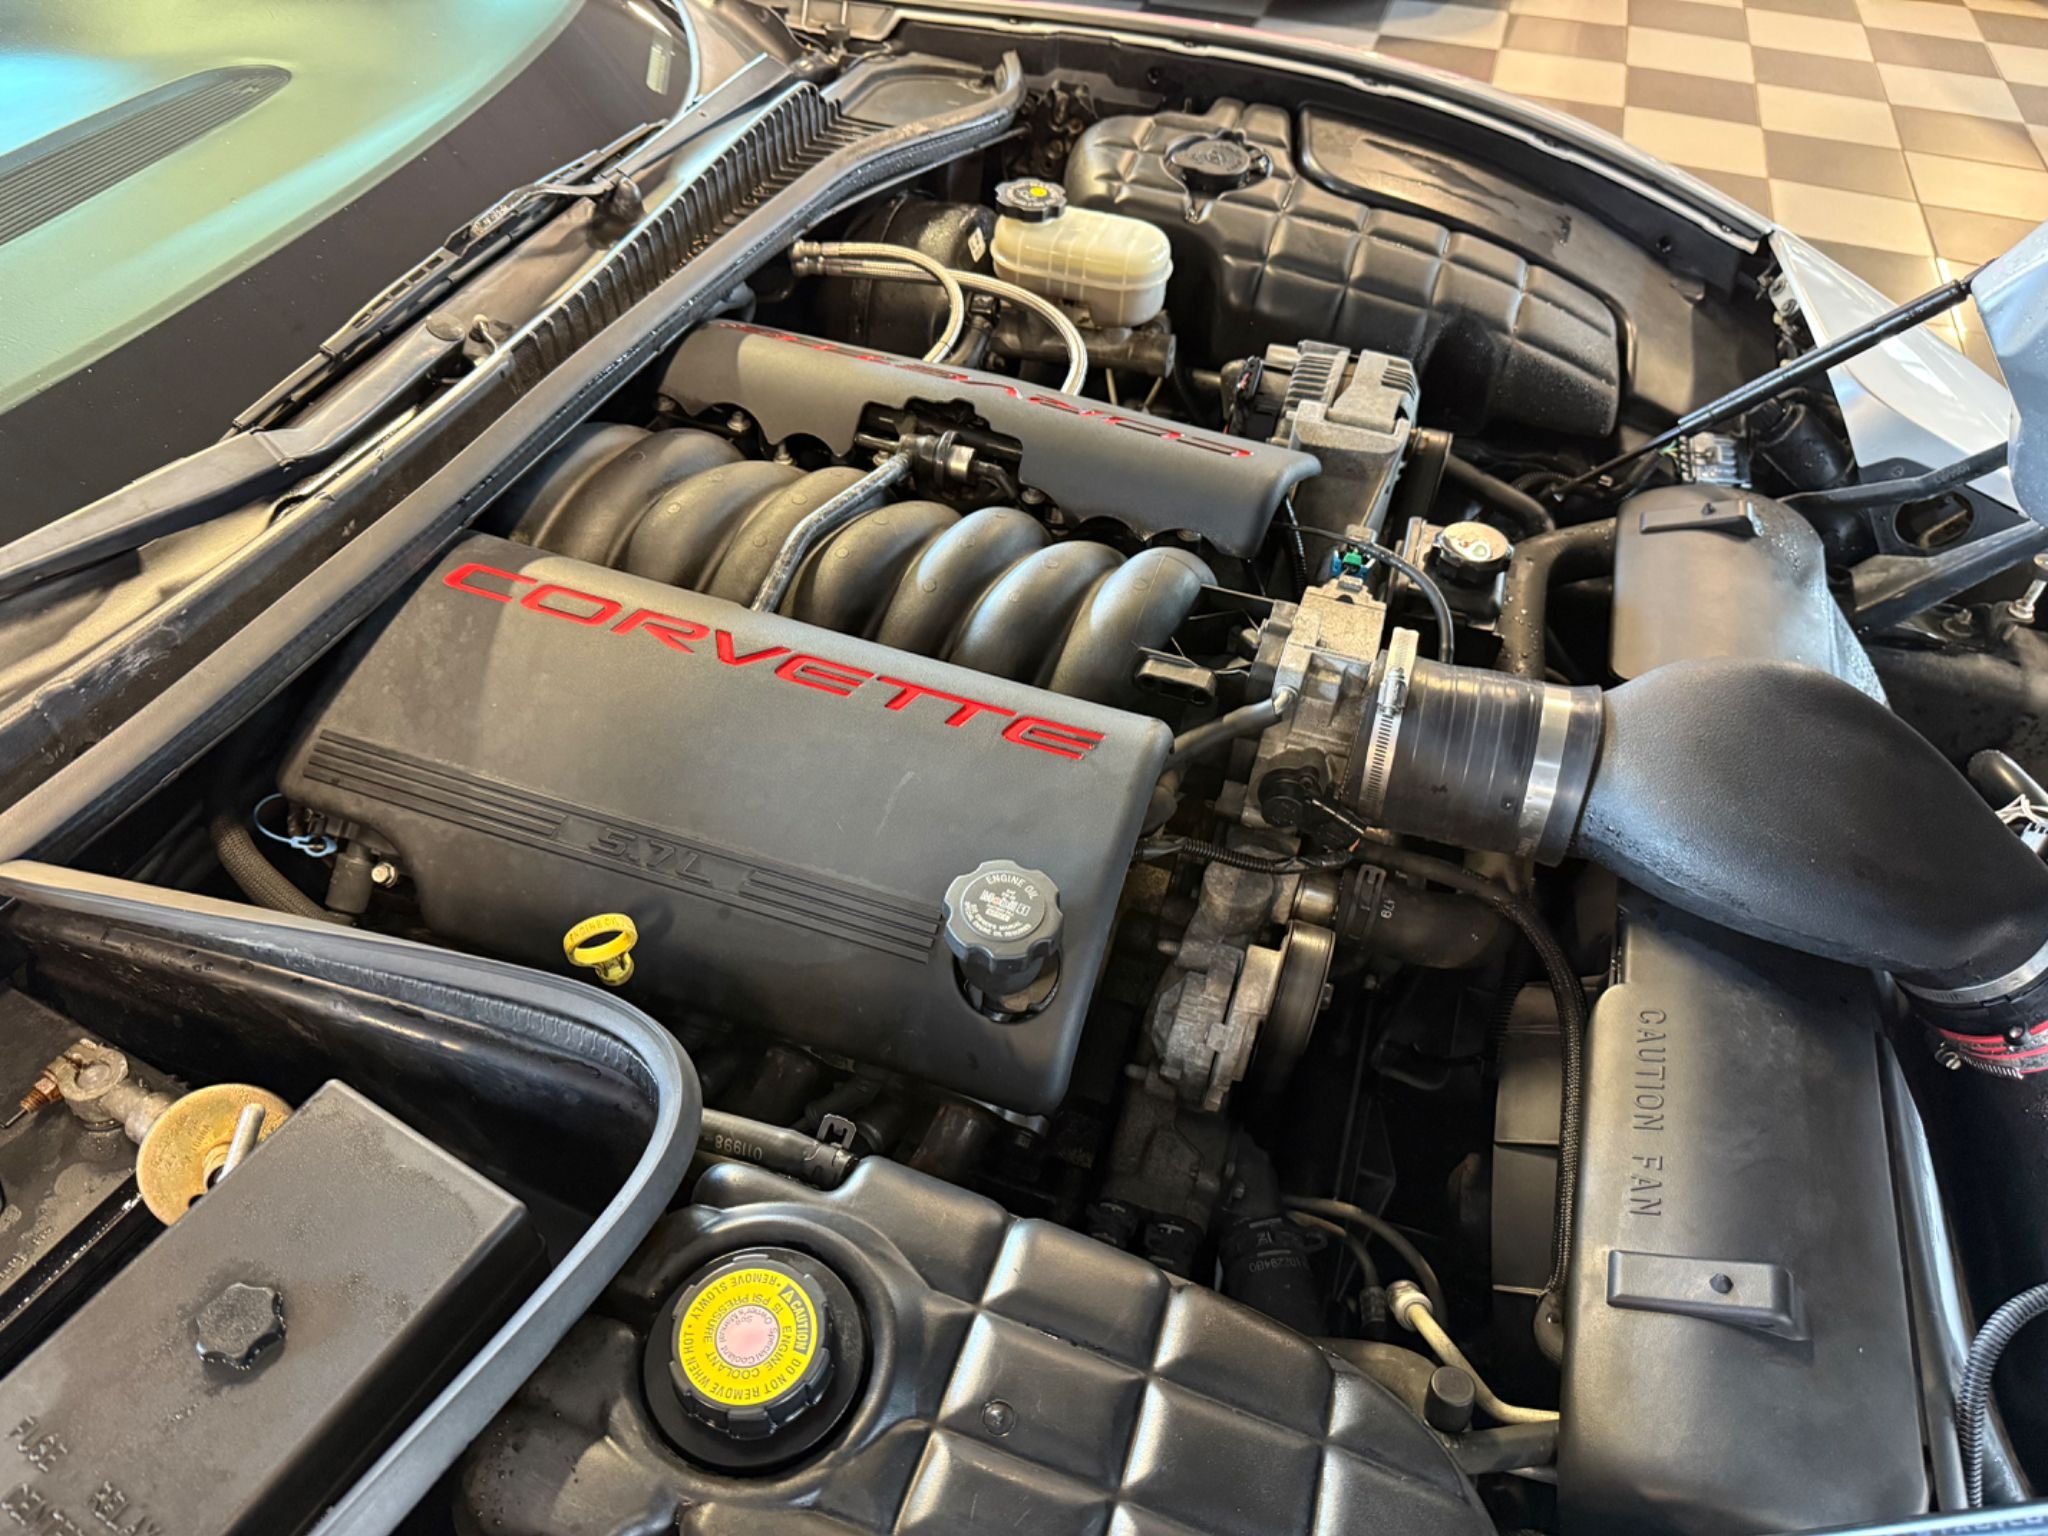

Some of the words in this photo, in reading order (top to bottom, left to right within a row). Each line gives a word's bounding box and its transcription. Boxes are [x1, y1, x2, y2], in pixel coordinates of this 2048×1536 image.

[441, 561, 1106, 762] CORVETTE
[589, 827, 712, 886] 5.7L
[985, 873, 1026, 888] ENGINE
[1024, 884, 1039, 900] OIL
[1632, 1008, 1667, 1131] CAUTION
[714, 1133, 763, 1161] 011998
[1628, 1155, 1664, 1217] FAN
[731, 1273, 778, 1288] REMOVE
[693, 1281, 728, 1320] SLOWLY
[751, 1293, 771, 1306] PSI
[772, 1302, 784, 1315] 15
[702, 1293, 749, 1344] PRESSURE
[718, 1313, 740, 1343] Manual
[739, 1308, 773, 1325] Owner's
[789, 1299, 808, 1352] CAUTION
[682, 1331, 696, 1354] HOT
[720, 1344, 756, 1365] Coolant
[756, 1327, 778, 1362] Special
[766, 1325, 793, 1372] ENGINE
[684, 1355, 711, 1388] WHEN
[704, 1350, 761, 1380] COOLANT
[785, 1358, 801, 1376] DO
[709, 1381, 760, 1400] REMOVE
[764, 1374, 788, 1394] NOT
[6, 1415, 68, 1472] FUSE
[0, 1482, 84, 1536] CENTE
